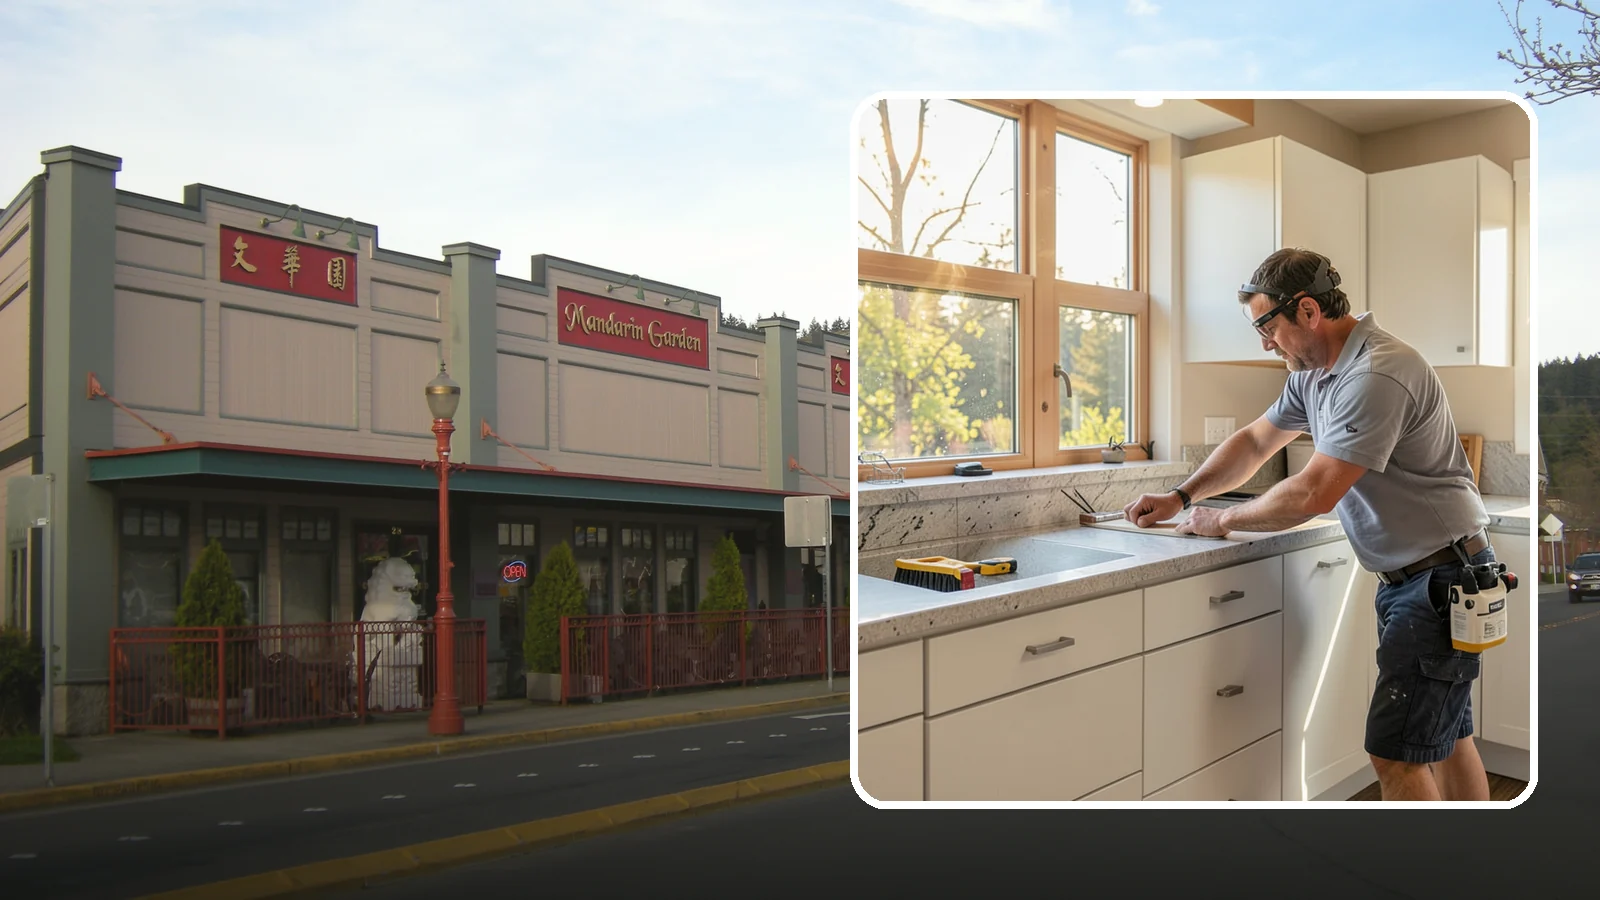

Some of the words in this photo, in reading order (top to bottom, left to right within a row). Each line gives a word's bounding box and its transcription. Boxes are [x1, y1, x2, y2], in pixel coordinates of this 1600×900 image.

[230, 235, 347, 291] 文華園
[564, 302, 644, 341] Mandarin
[648, 320, 701, 352] Garden
[503, 565, 527, 578] OPEN
